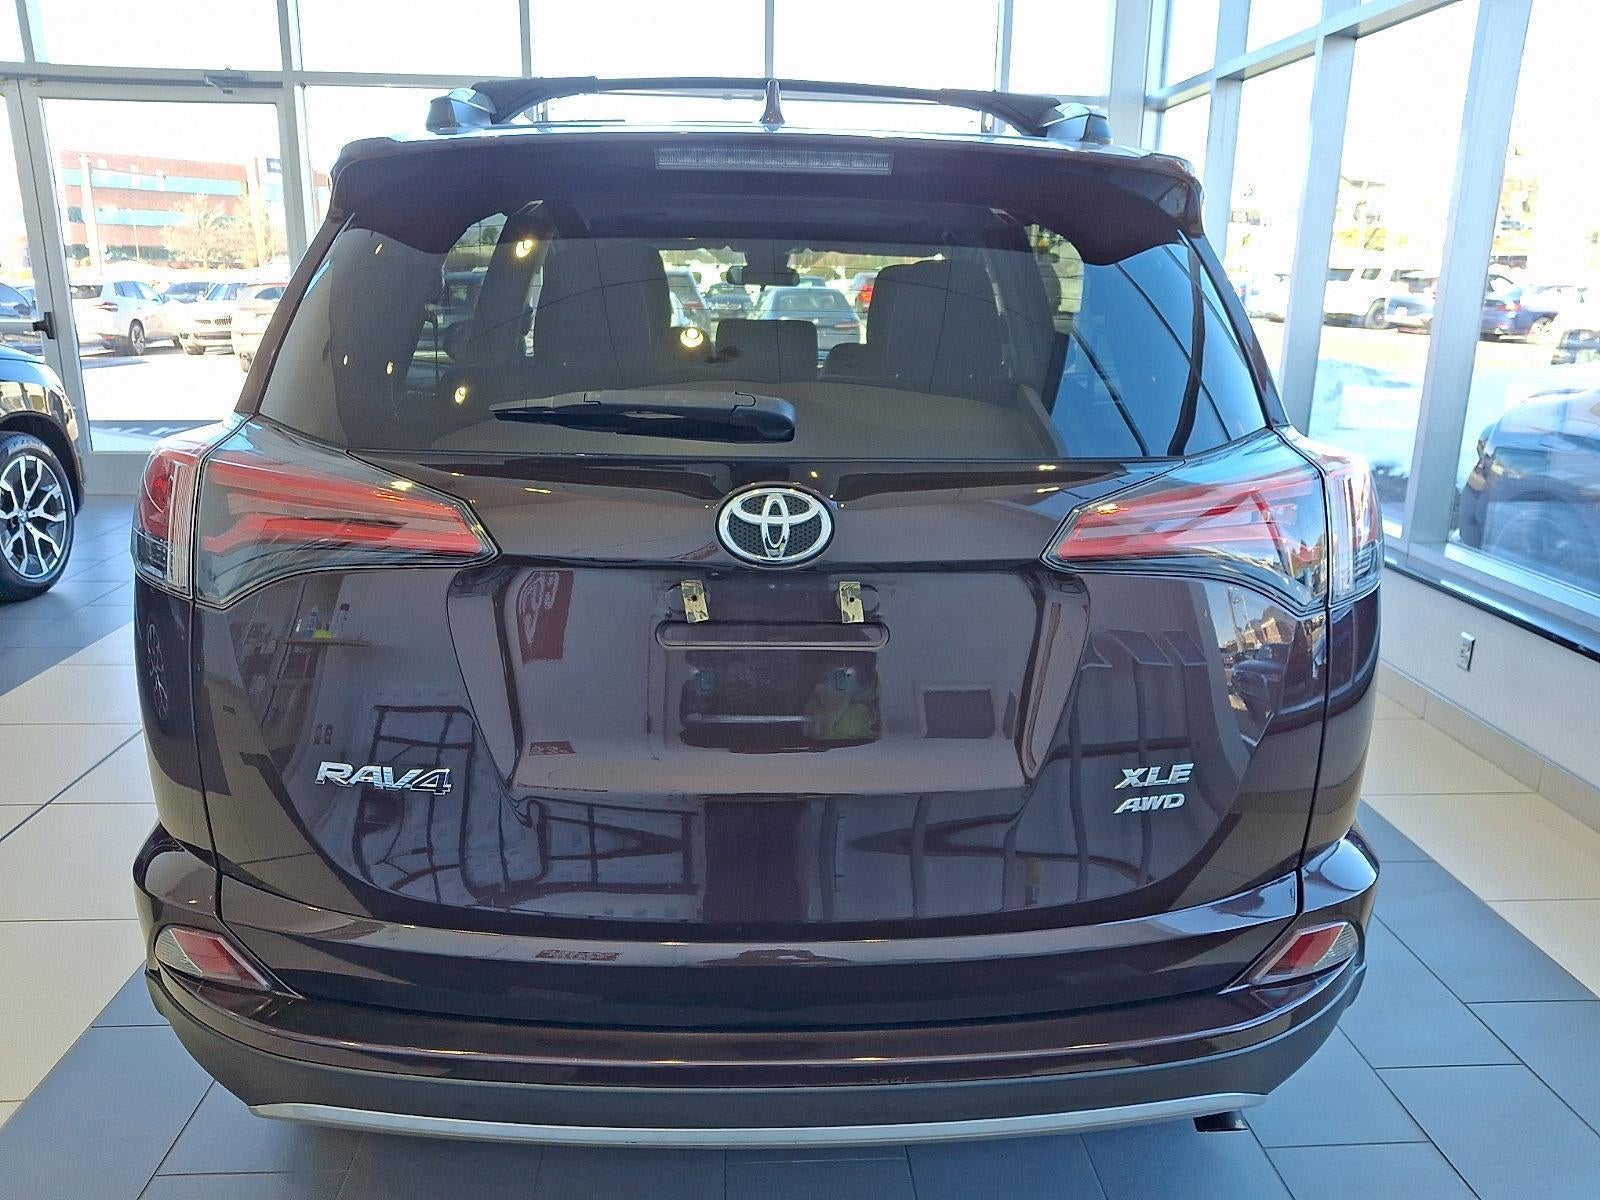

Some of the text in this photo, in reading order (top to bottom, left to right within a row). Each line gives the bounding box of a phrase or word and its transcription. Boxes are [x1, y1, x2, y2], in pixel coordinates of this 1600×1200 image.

[315, 761, 451, 795] RAV4
[1114, 763, 1194, 790] XLE
[1113, 793, 1186, 814] AWD
